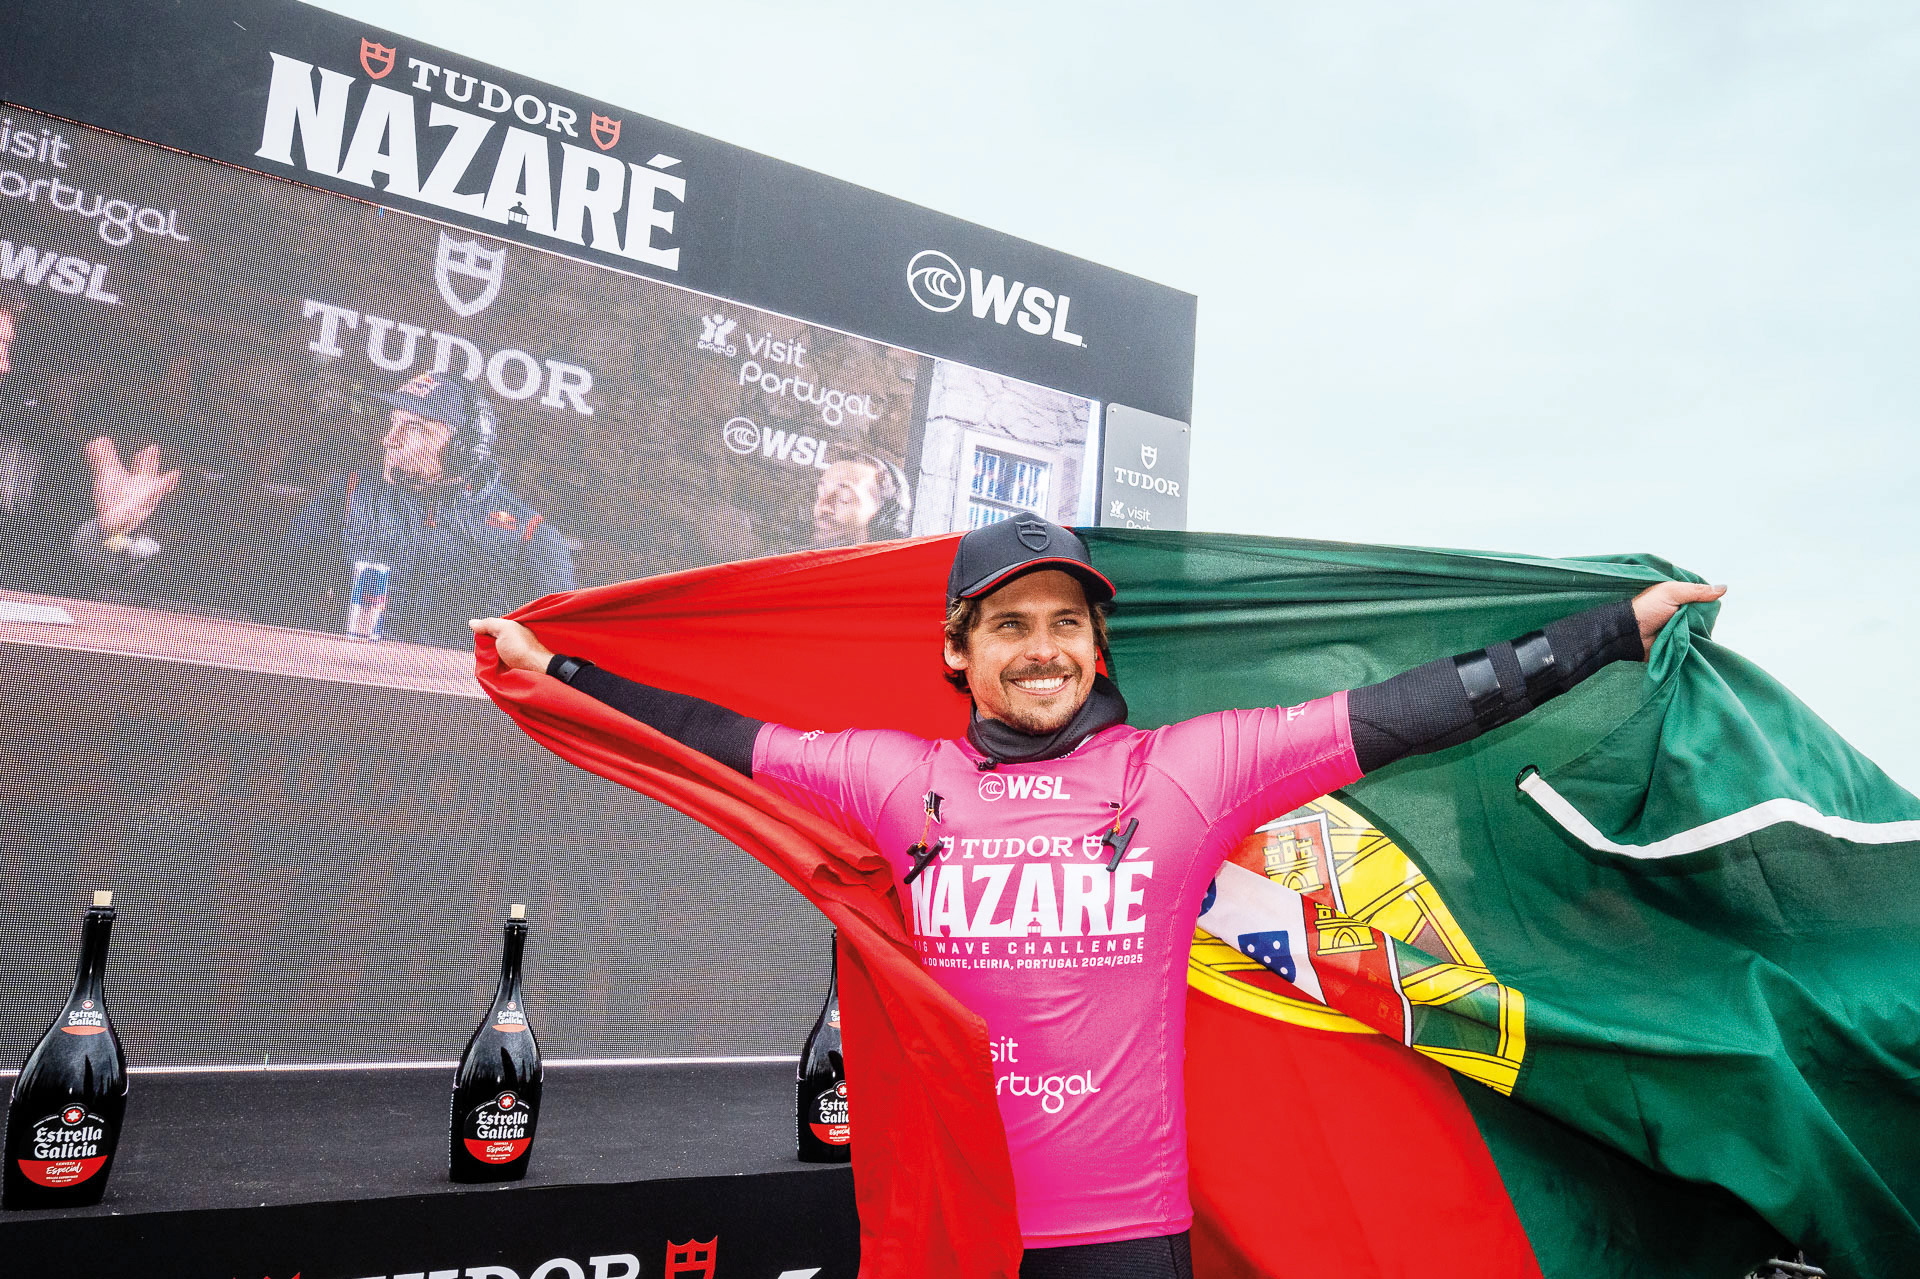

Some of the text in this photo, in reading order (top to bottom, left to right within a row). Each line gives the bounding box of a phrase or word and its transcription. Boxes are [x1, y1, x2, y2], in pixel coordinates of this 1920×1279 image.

[408, 57, 579, 138] TUDOR
[0, 118, 70, 169] isit
[254, 51, 687, 271] NAZARÉ
[0, 170, 190, 248] ortugal
[969, 267, 1083, 347] WSL
[302, 298, 595, 416] TUDOR
[745, 332, 807, 368] visit
[738, 360, 879, 427] portugal
[762, 426, 833, 470] WSL
[1114, 466, 1180, 498] TUDOR
[1127, 506, 1151, 522] visit
[1007, 775, 1071, 801] WSL
[961, 836, 1074, 859] TUDOR
[909, 847, 1154, 938] NAZARÉ
[936, 942, 990, 955] WAVE
[1007, 937, 1145, 955] CHALLENGE
[939, 958, 971, 970] NORTE,
[973, 959, 1014, 970] LEIRIA,
[1016, 958, 1079, 970] PORTUGAL
[1081, 953, 1144, 968] 2024/2025
[68, 1010, 103, 1020] Estrella
[68, 1018, 101, 1026] Galicia
[989, 1035, 1019, 1063] sit
[819, 1098, 849, 1111] Estre
[995, 1069, 1101, 1114] rtugal
[476, 1110, 529, 1125] Estrella
[33, 1126, 103, 1143] Estrella
[476, 1124, 525, 1139] Galicia
[34, 1141, 98, 1159] Galicia
[46, 1162, 83, 1175] Especial
